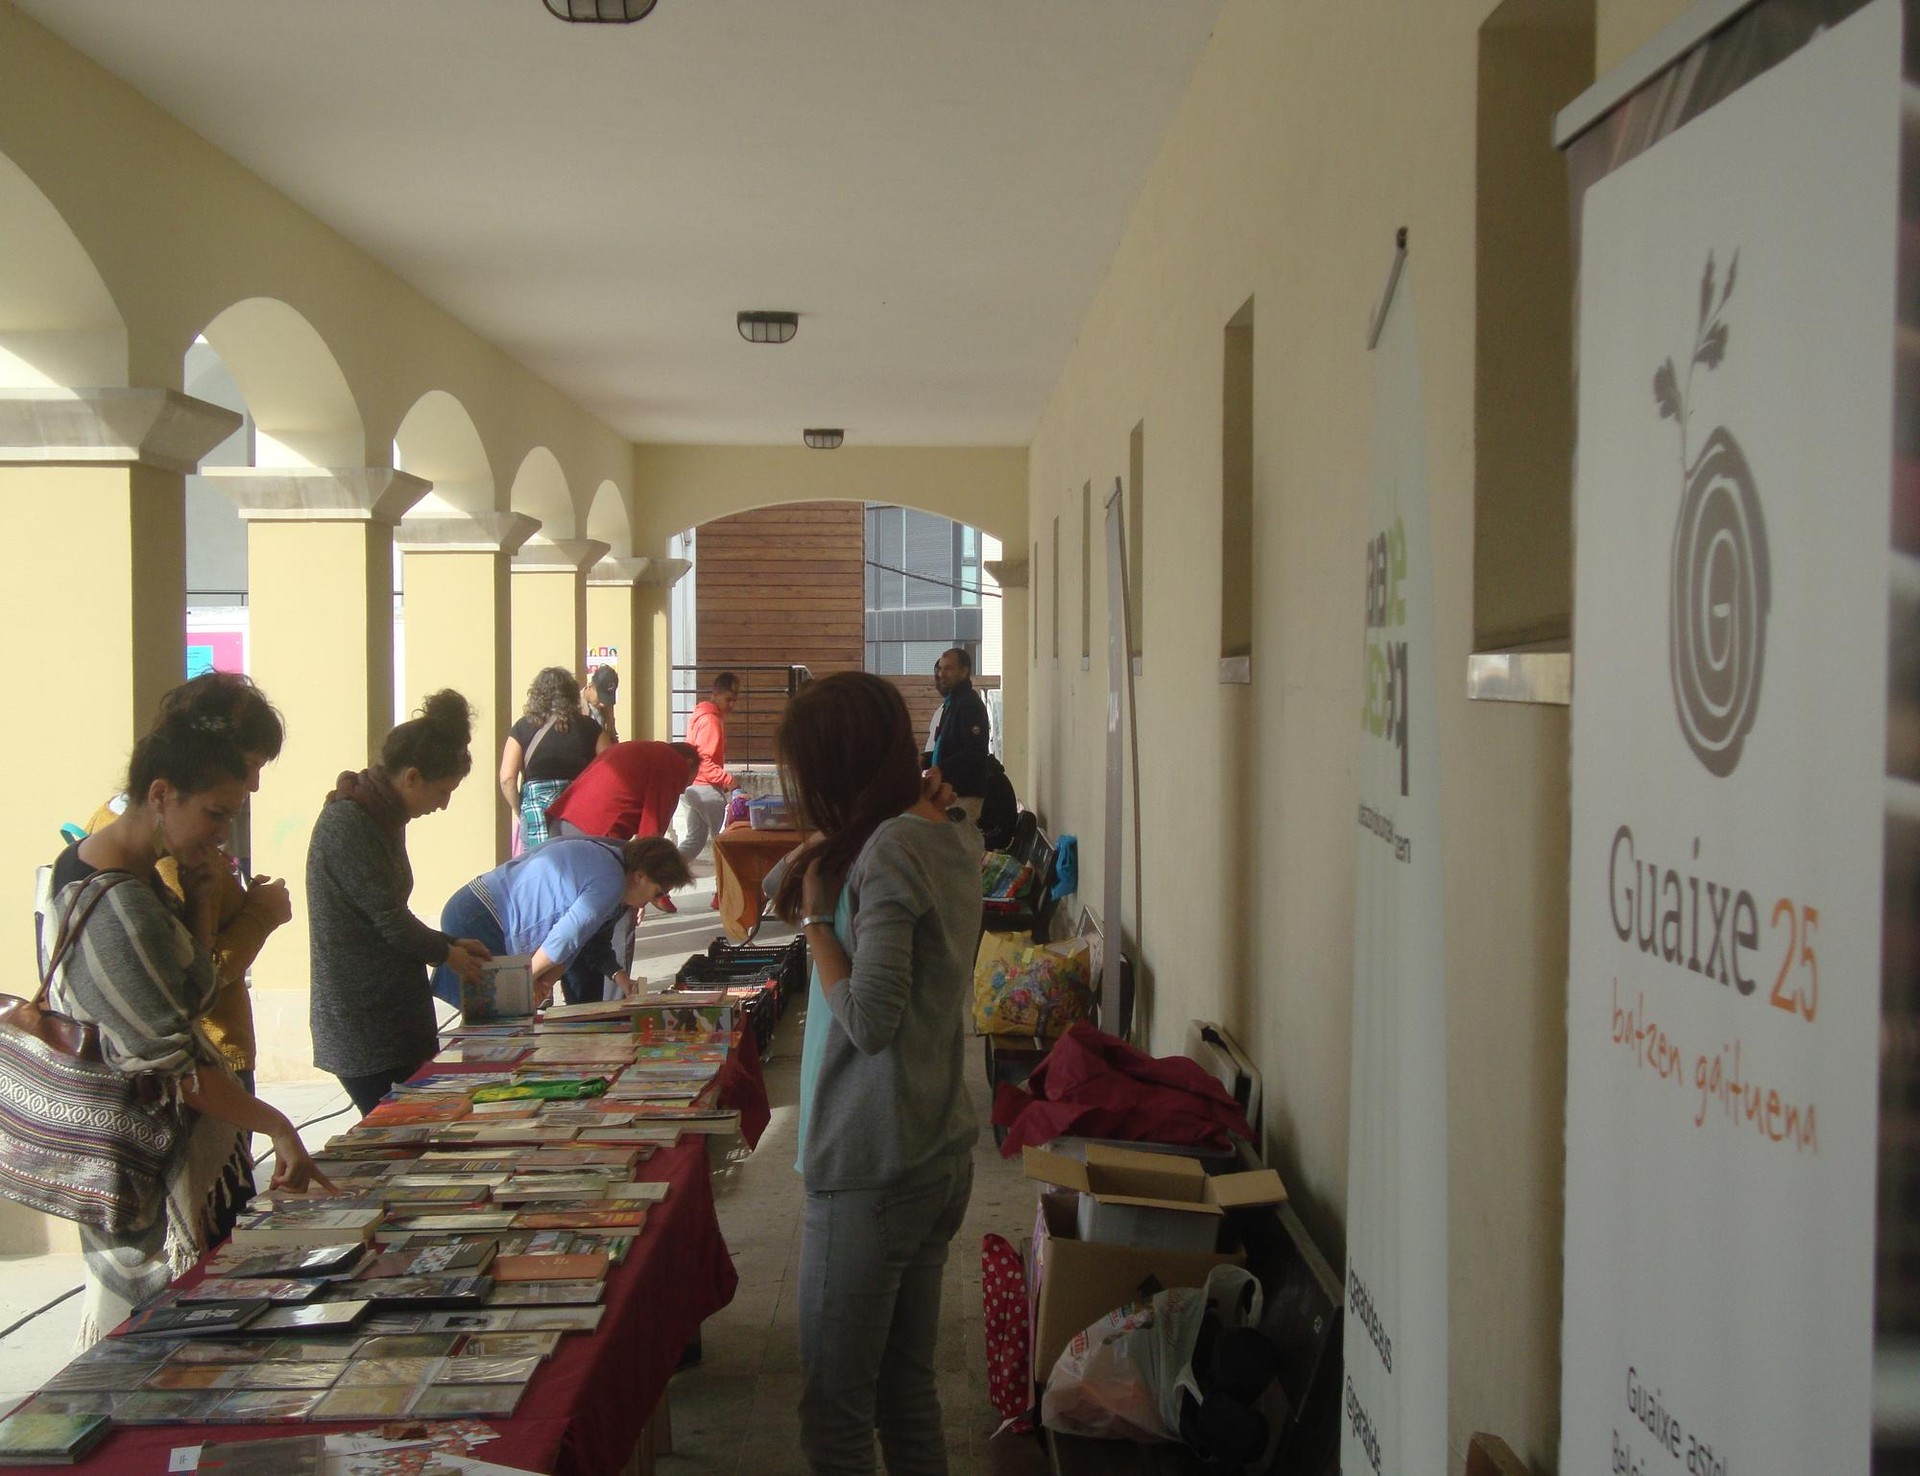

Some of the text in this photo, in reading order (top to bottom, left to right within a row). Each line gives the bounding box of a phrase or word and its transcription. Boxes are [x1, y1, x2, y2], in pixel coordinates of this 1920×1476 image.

[1610, 825, 1818, 1023] Guaixe 25
[1626, 1365, 1681, 1459] Guaixe
